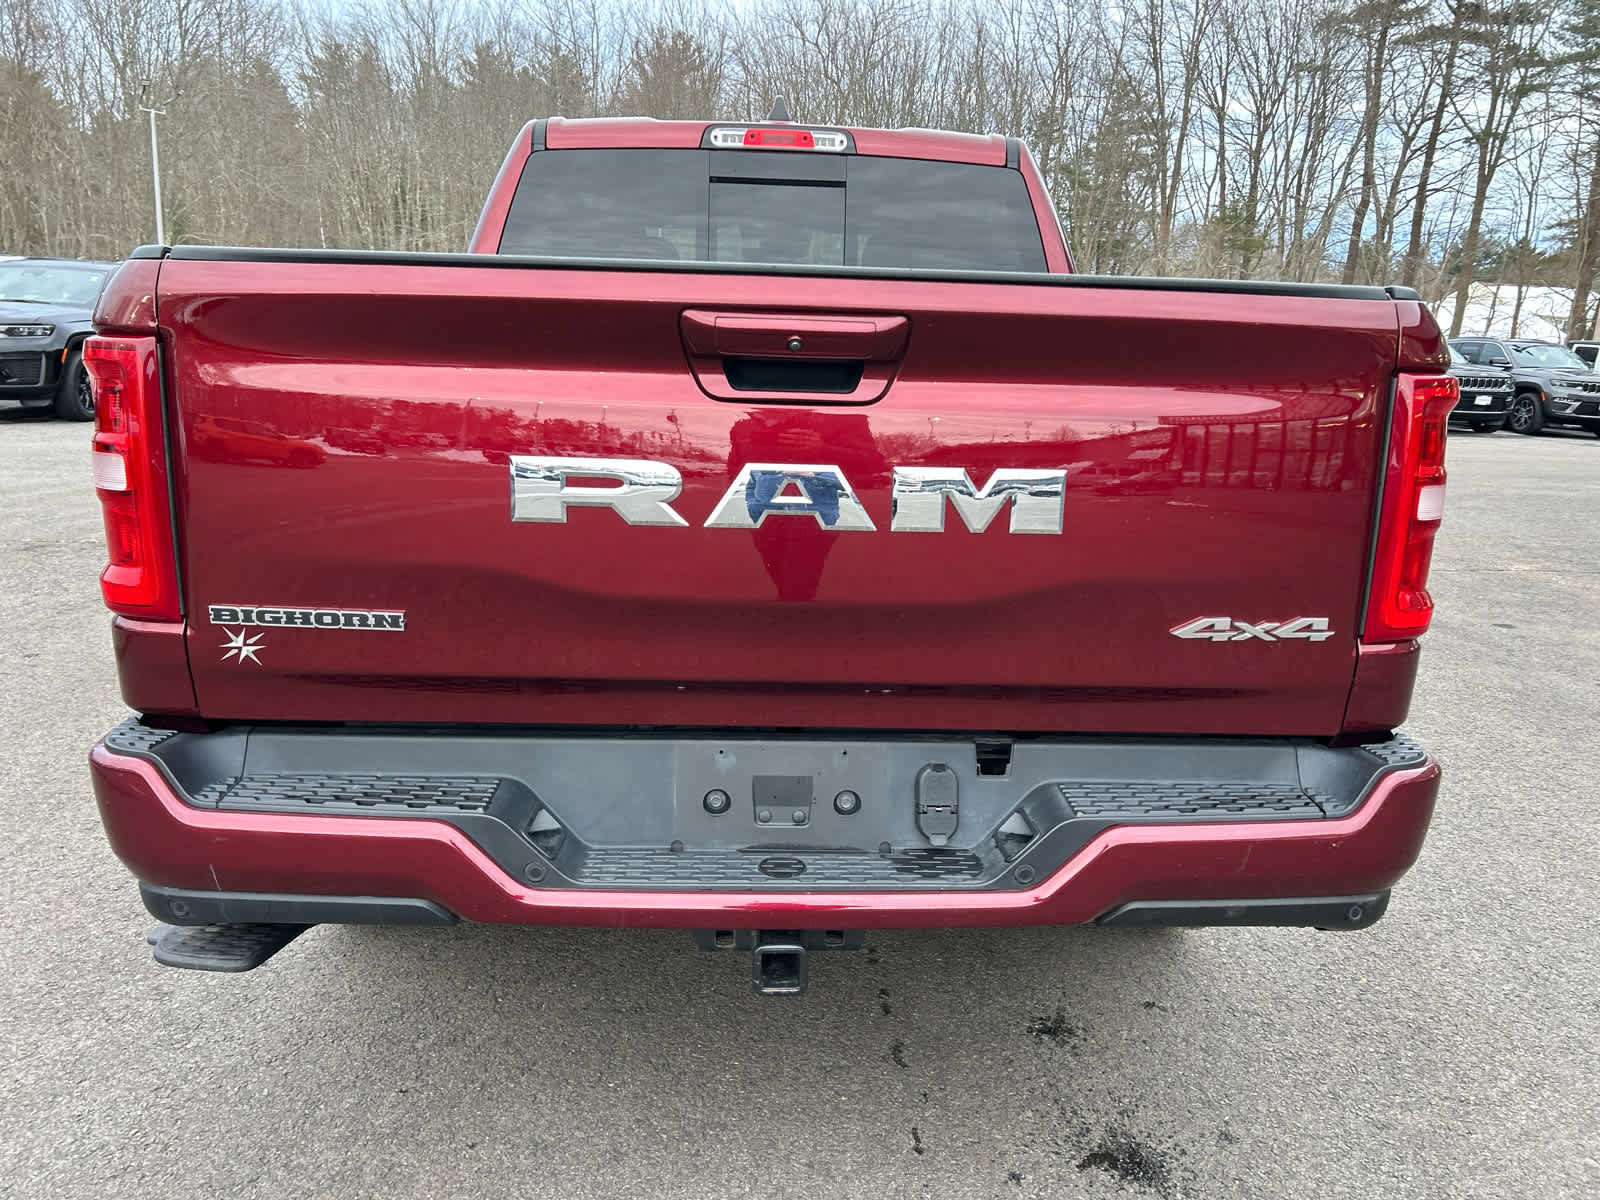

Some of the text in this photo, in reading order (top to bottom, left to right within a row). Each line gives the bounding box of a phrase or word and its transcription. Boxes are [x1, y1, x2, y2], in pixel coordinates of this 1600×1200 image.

[510, 455, 1068, 534] RAM
[208, 604, 405, 631] BIGHORN
[1170, 616, 1336, 641] 4x4
